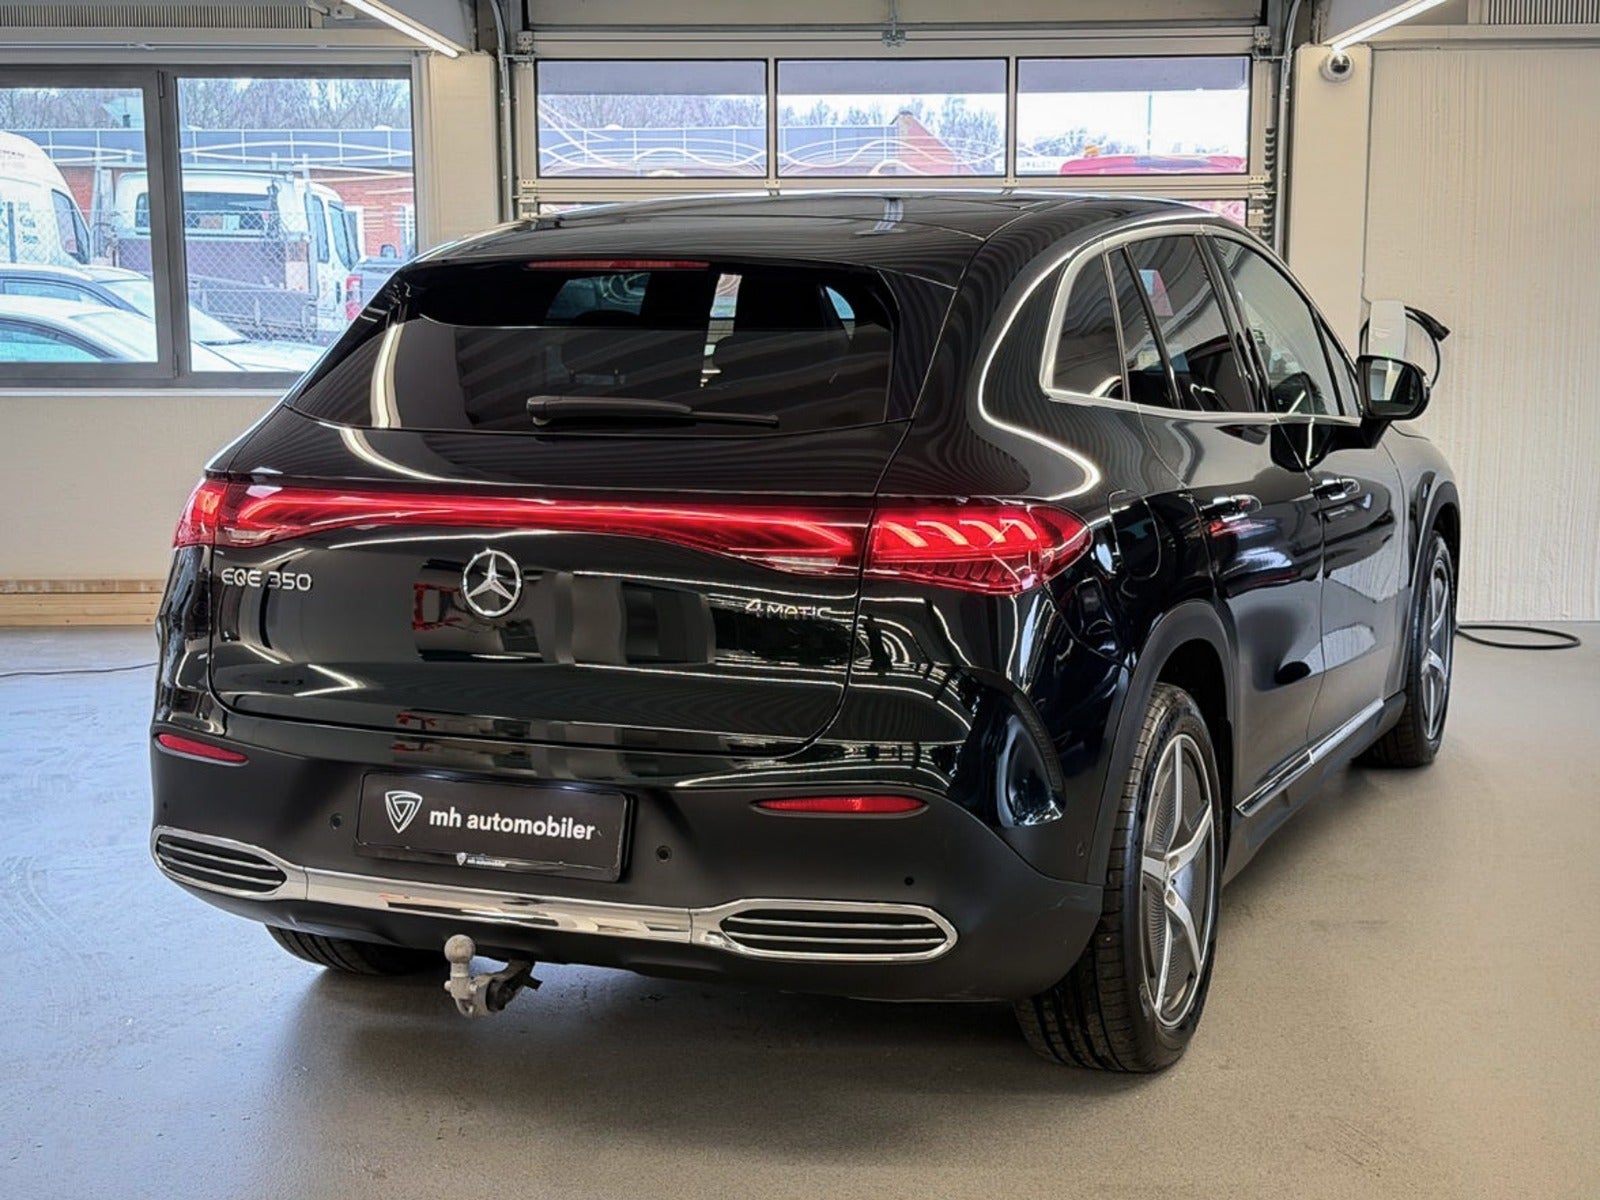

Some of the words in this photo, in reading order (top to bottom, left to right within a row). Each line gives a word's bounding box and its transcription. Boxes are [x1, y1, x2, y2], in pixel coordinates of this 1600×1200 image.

[221, 567, 262, 588] EQE
[267, 570, 312, 591] 350
[429, 806, 462, 828] mh
[466, 811, 596, 841] automobiler
